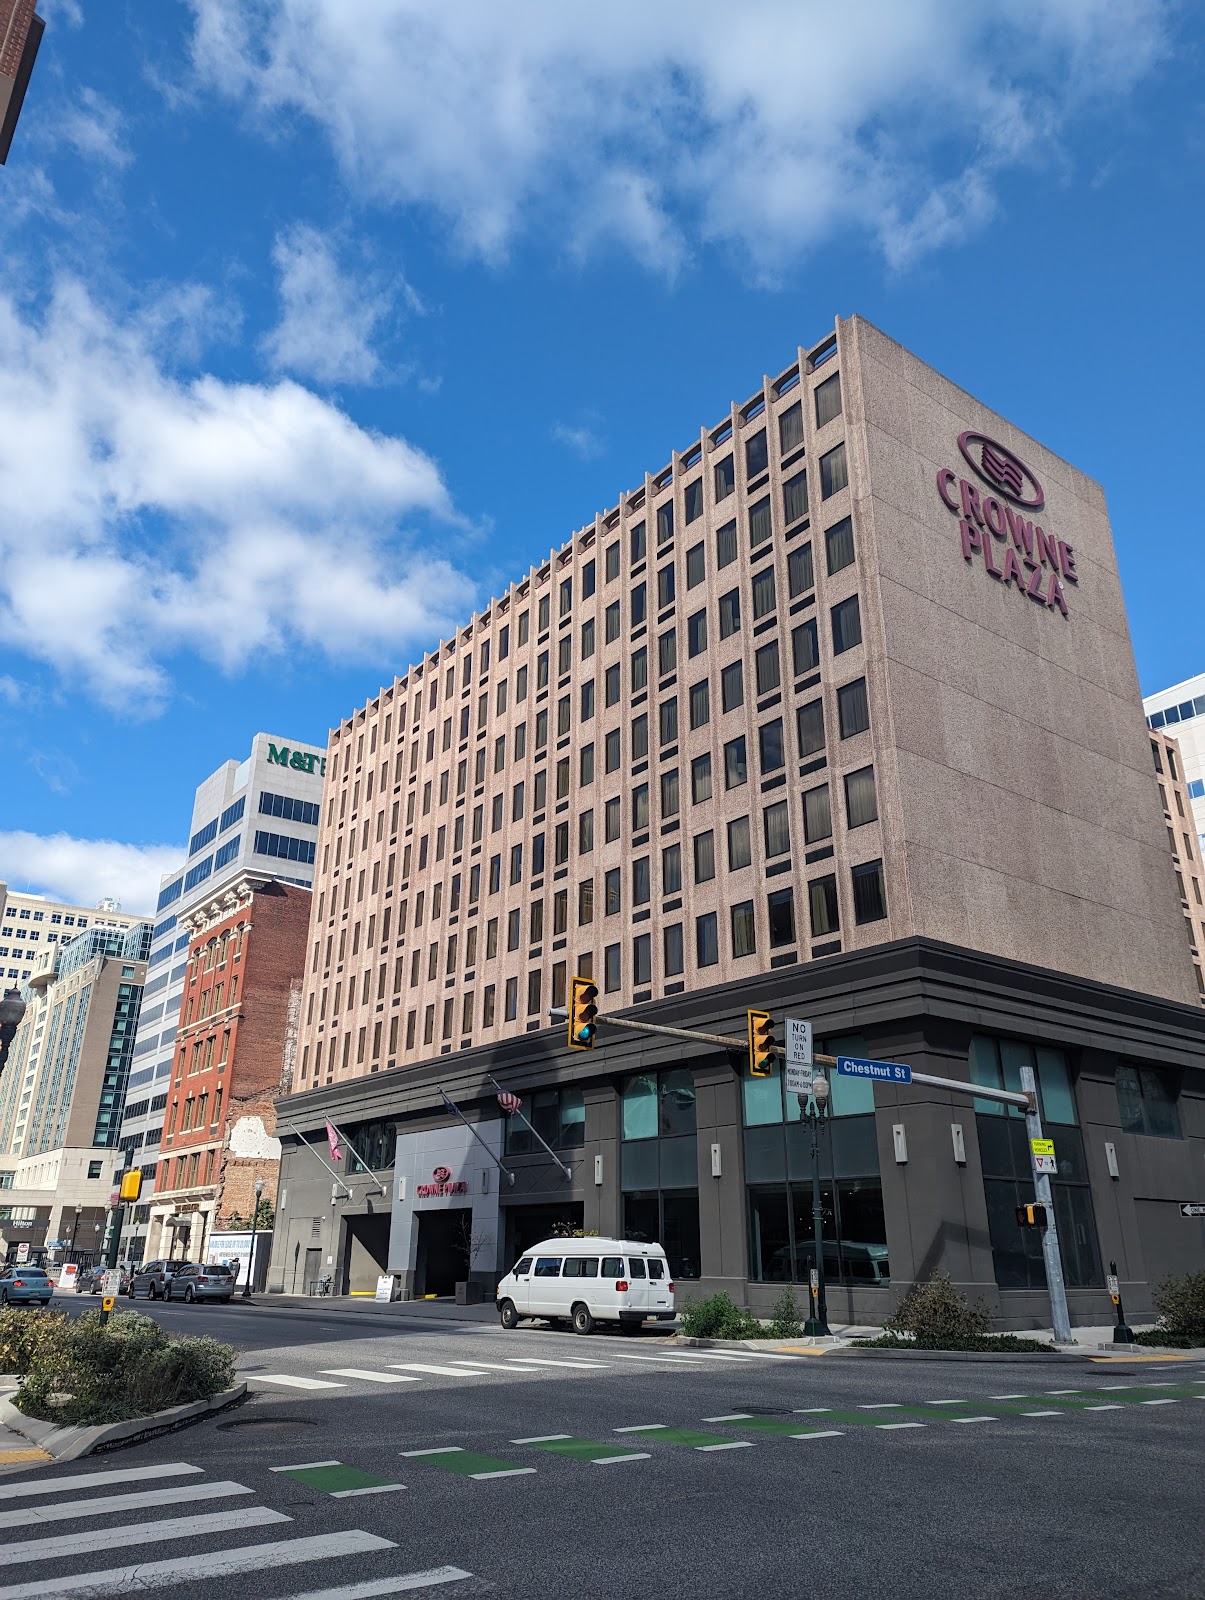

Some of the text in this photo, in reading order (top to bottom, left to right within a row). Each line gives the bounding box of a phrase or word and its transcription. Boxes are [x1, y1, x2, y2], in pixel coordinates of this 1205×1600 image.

[937, 468, 1078, 583] CROWNE
[959, 520, 1069, 616] PLAZA
[266, 742, 320, 775] M&T
[792, 1022, 806, 1033] NO
[792, 1034, 807, 1042] TURN
[794, 1043, 804, 1051] ON
[793, 1052, 806, 1060] RED
[843, 1060, 906, 1079] Chestnut St
